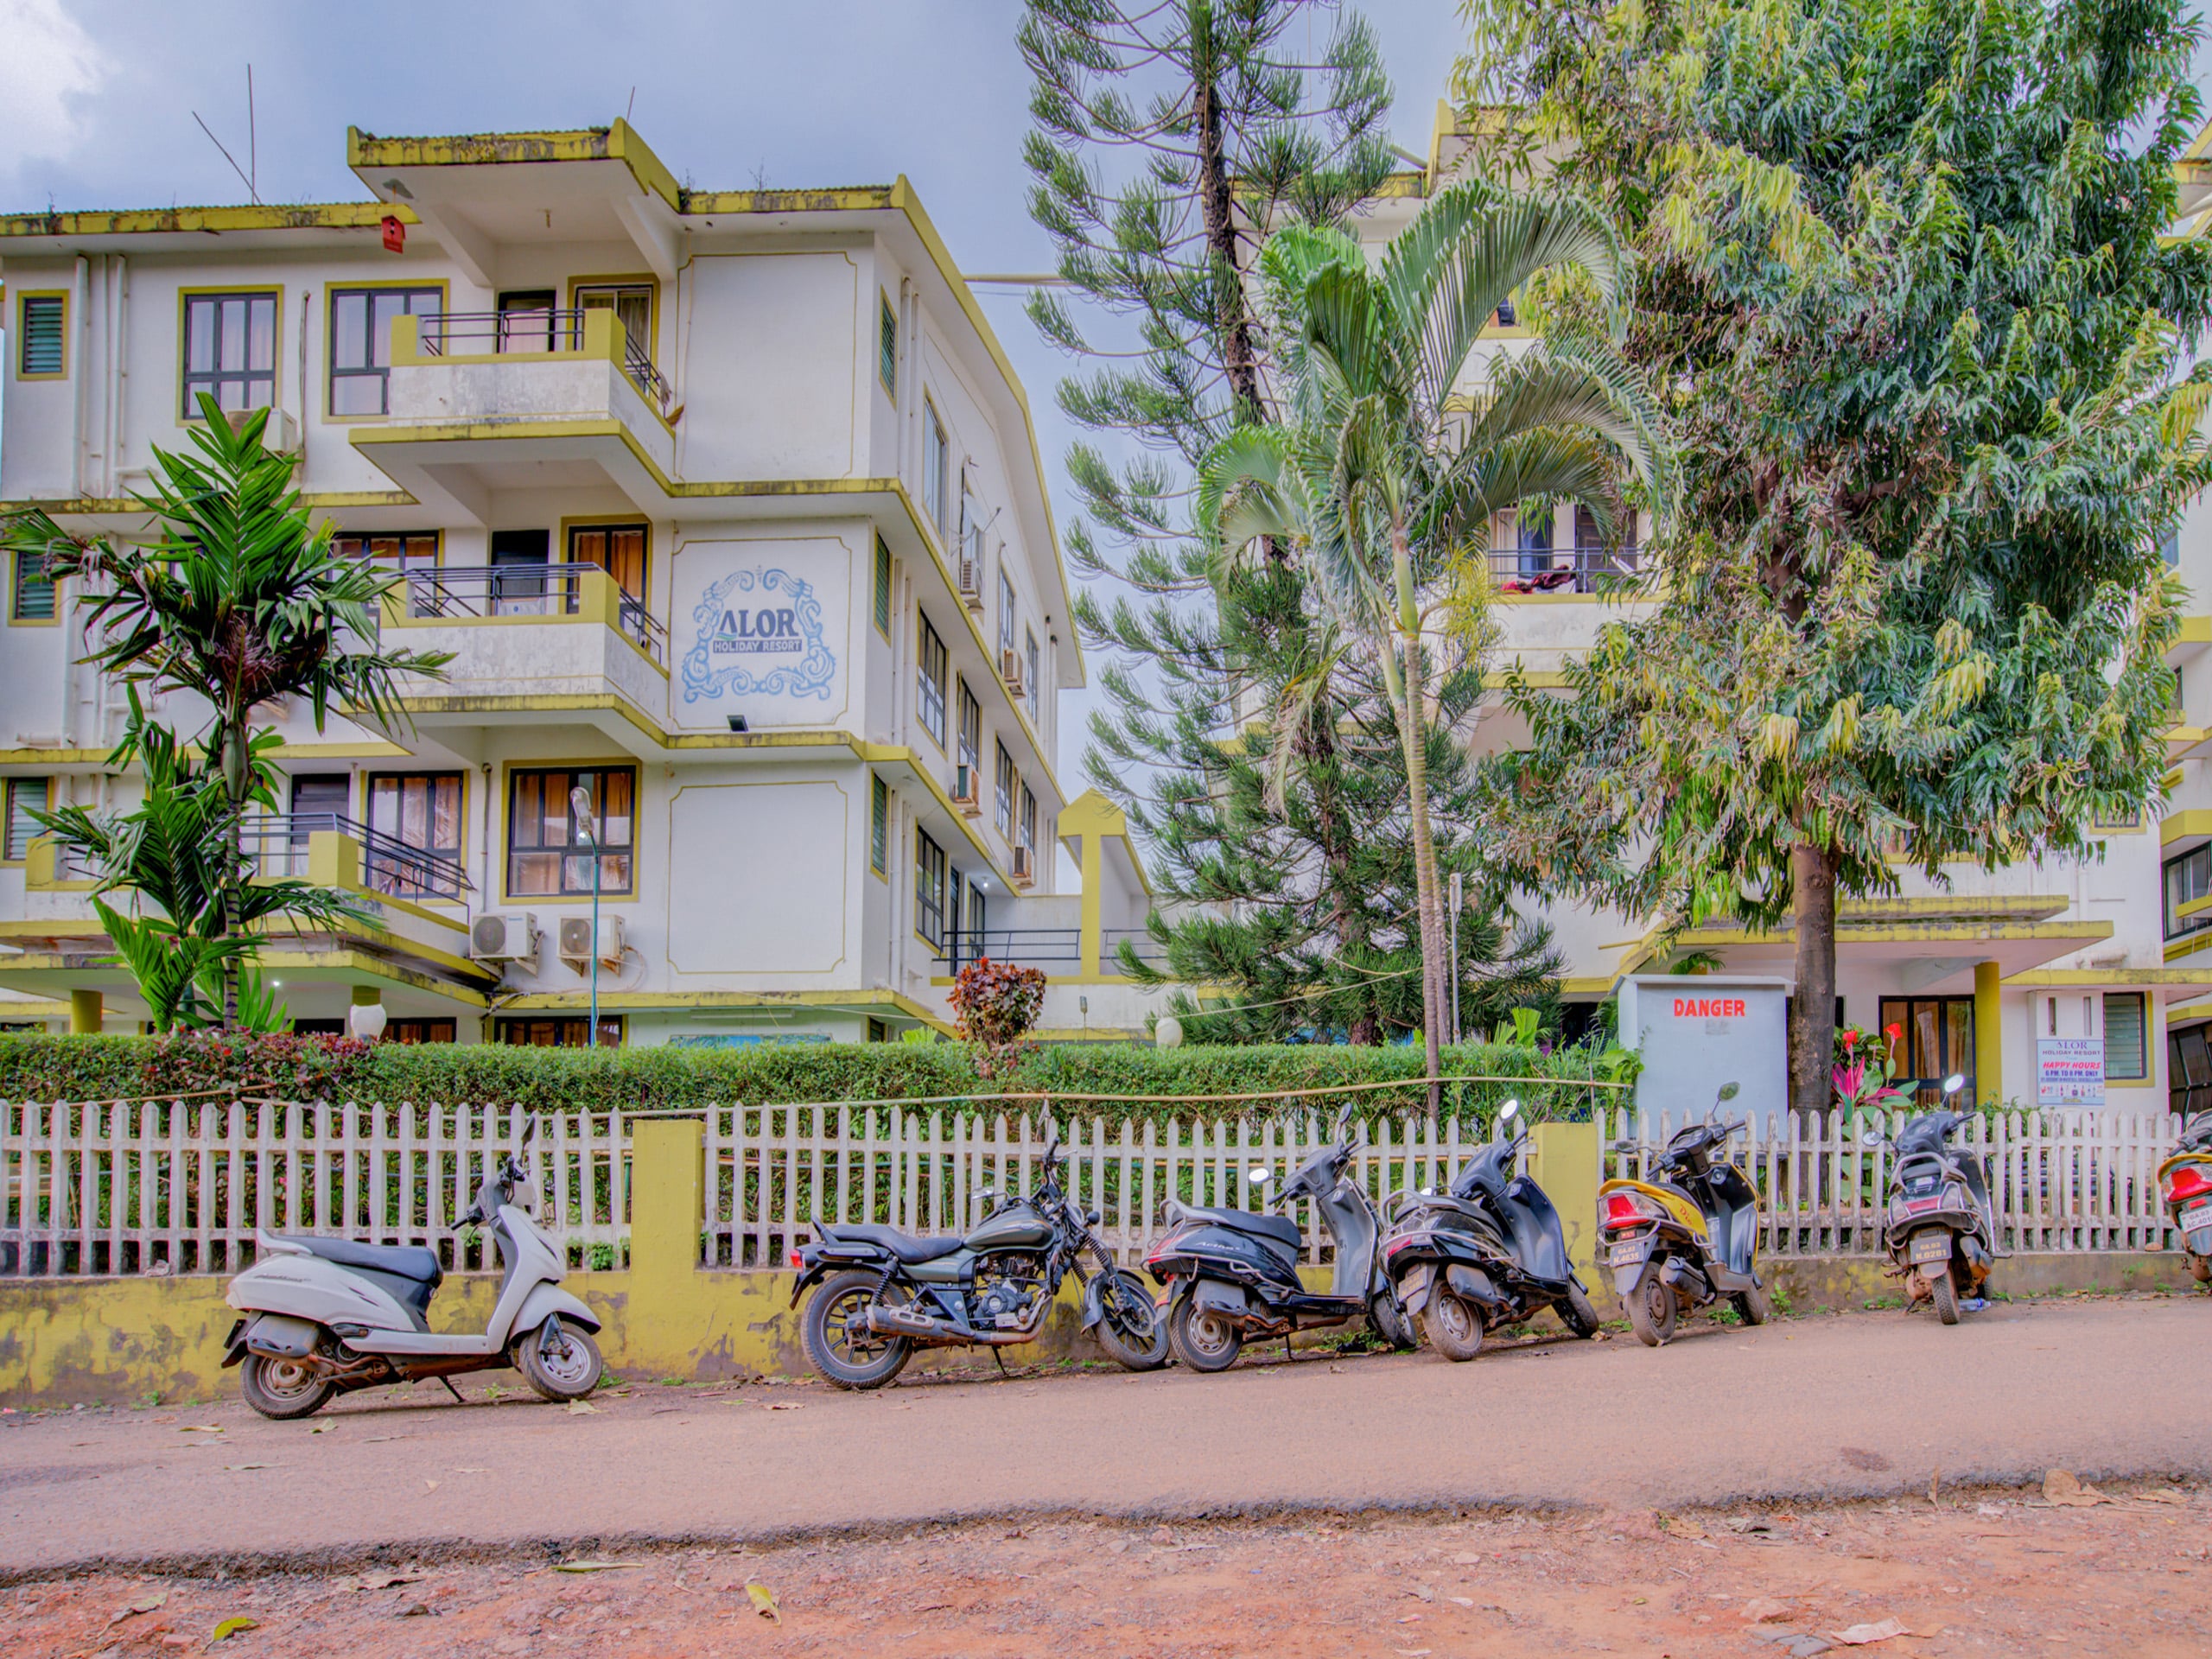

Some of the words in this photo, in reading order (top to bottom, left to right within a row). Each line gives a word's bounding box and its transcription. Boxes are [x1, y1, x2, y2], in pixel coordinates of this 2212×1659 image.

[718, 608, 799, 638] ALOR
[714, 641, 760, 652] HOLIDAY
[762, 640, 800, 652] RESORT
[1674, 998, 1745, 1017] DANGER
[2072, 1061, 2101, 1070] HOURS
